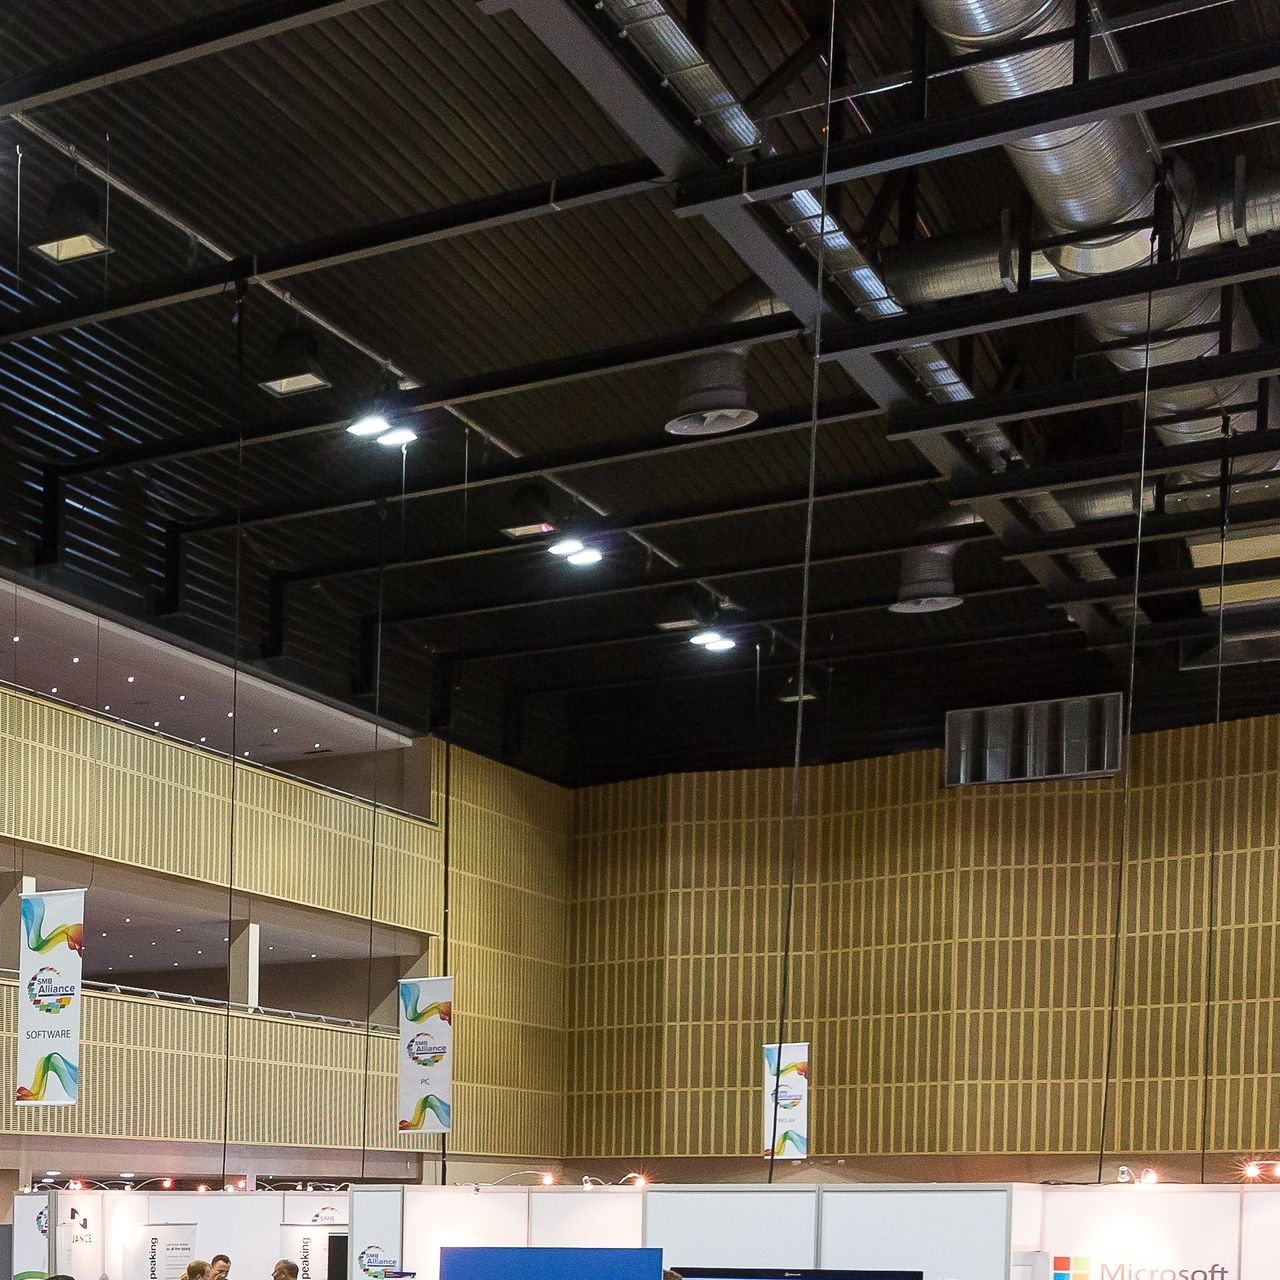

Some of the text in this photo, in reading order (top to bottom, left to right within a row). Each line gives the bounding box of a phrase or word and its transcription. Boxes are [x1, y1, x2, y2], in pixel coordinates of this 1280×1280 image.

[38, 985, 76, 994] Alliance
[26, 1030, 71, 1040] SOFTWARE
[420, 1078, 430, 1086] PC
